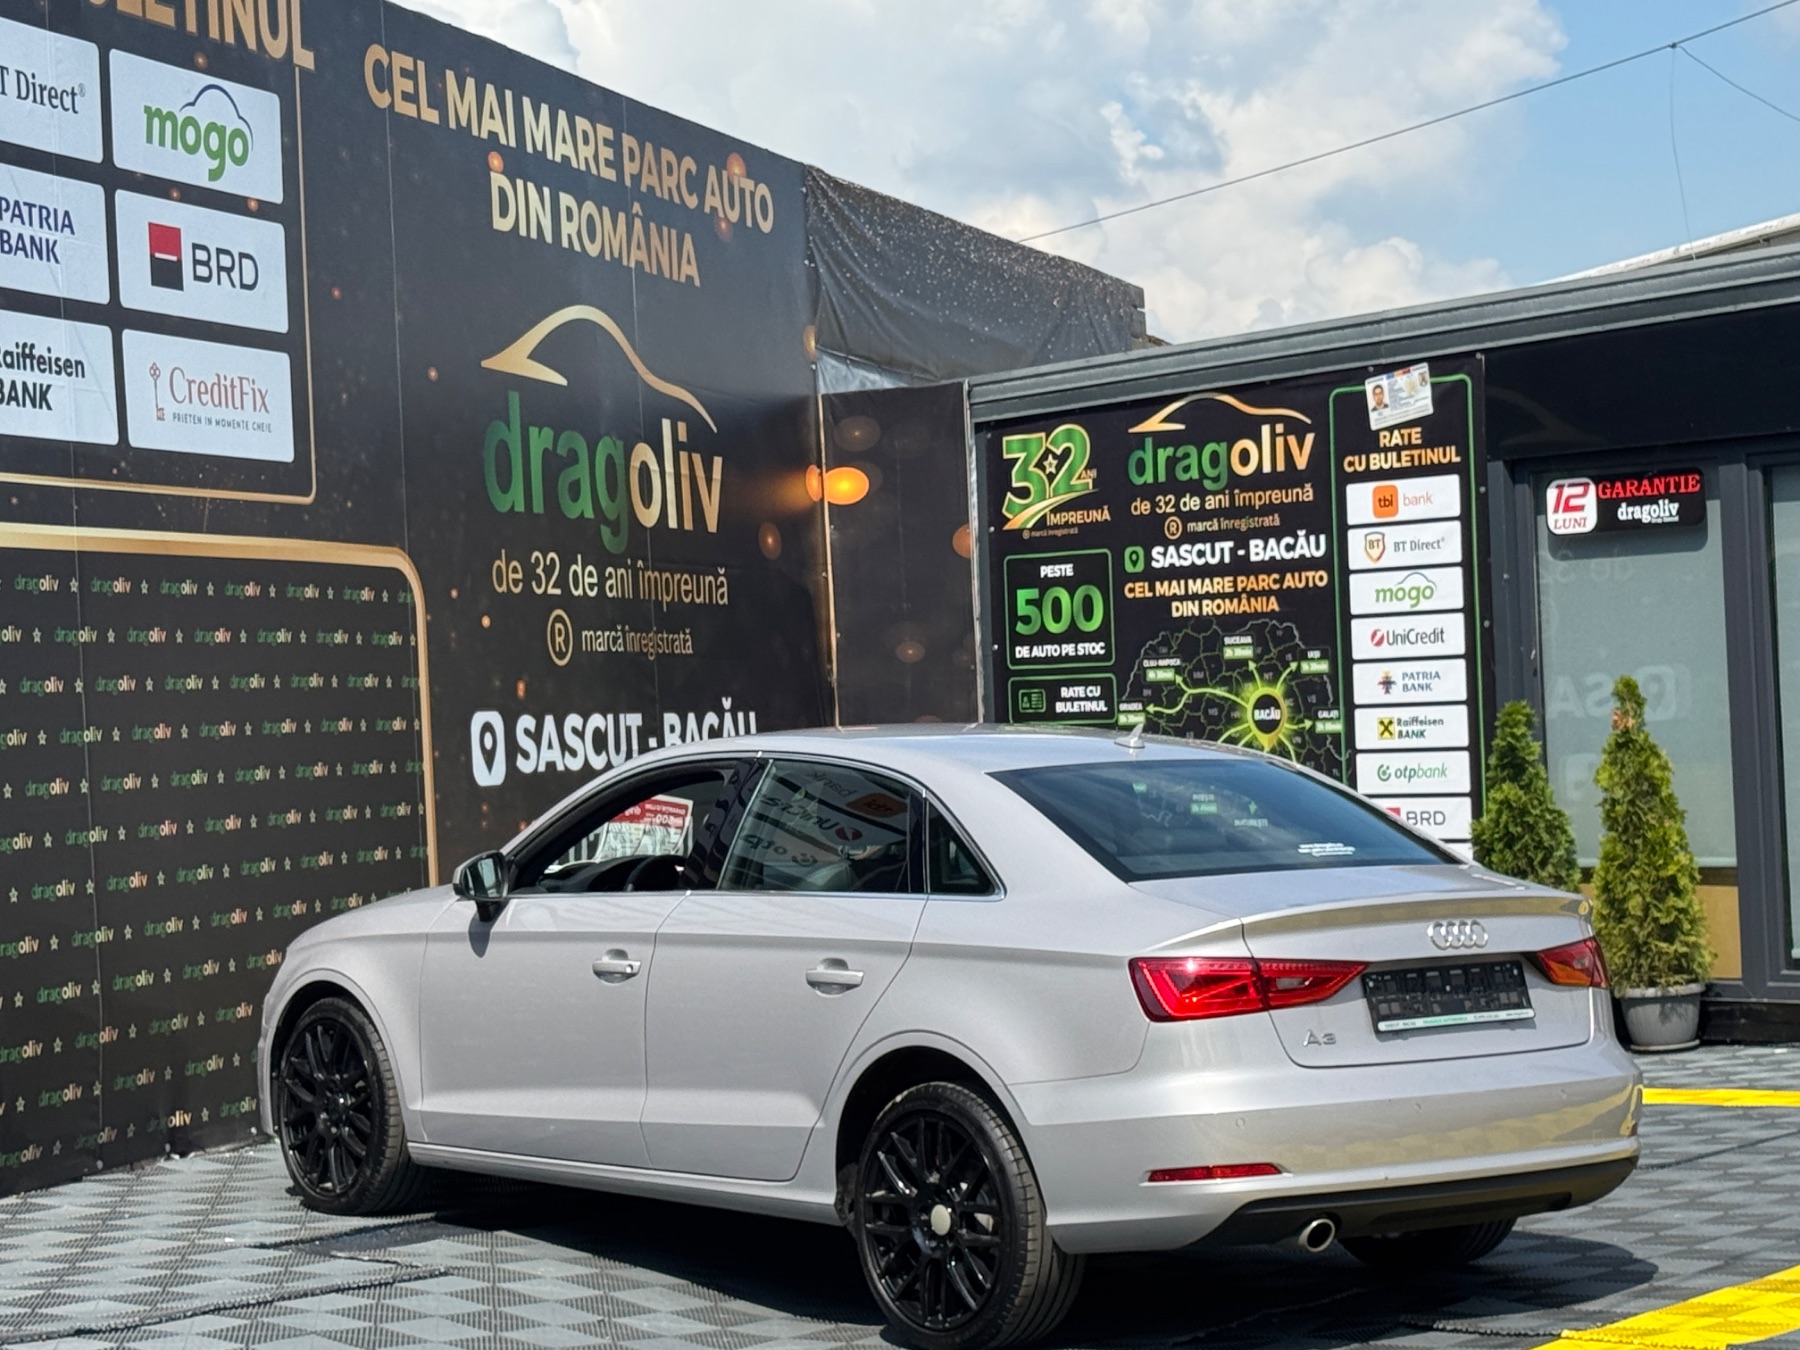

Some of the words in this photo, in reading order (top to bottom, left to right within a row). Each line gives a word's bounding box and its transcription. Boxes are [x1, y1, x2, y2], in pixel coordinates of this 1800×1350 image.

[144, 104, 249, 182] mogo
[364, 44, 439, 125] CEL
[445, 69, 516, 148] MAI
[522, 96, 616, 183] MARE
[622, 133, 698, 209] PARC
[704, 164, 774, 234] AUTO
[0, 196, 76, 236] PATRIA
[490, 170, 552, 245] DIN
[559, 191, 700, 287] ROMÂNIA
[0, 228, 61, 265] BANK
[191, 242, 259, 292] BRD
[0, 342, 86, 379] aiffeisen
[170, 366, 270, 414] CreditFix
[173, 412, 202, 425] PRIETEN
[205, 416, 212, 426] IN
[215, 418, 249, 431] MOMENTE
[252, 421, 272, 433] CHEIE
[1379, 427, 1422, 448] RATE
[1127, 423, 1315, 490] dragoliv
[1343, 454, 1366, 473] CU
[1369, 445, 1461, 470] BULETINUL
[483, 391, 723, 554] dragoliv
[1131, 498, 1150, 515] de
[1155, 494, 1176, 513] 32
[1180, 493, 1200, 511] de
[1205, 489, 1229, 510] ani
[1234, 483, 1313, 510] împreună
[1552, 482, 1590, 514] 12
[1597, 473, 1700, 499] GARANTIE
[1378, 495, 1393, 508] tbi
[1403, 491, 1433, 506] bank
[1617, 499, 1679, 523] dragoliv
[1046, 505, 1111, 526] ÎMPREUNĂ
[1187, 518, 1219, 532] marcă
[1220, 514, 1280, 531] înregistrată
[1553, 517, 1587, 530] LUNI
[1151, 541, 1234, 569] SASCUT
[1249, 530, 1326, 562] BACĂU
[1368, 538, 1381, 550] BT
[1394, 541, 1408, 552] BT
[492, 550, 523, 594] de
[530, 551, 562, 595] 32
[568, 554, 598, 597] de
[605, 559, 633, 599] ani
[637, 560, 728, 612] împreună
[1040, 564, 1074, 578] PESTE
[1124, 582, 1152, 598] CEL
[1155, 580, 1185, 596] MAI
[1188, 577, 1234, 595] MARE
[1237, 574, 1280, 592] PARC
[1283, 570, 1328, 589] AUTO
[14, 574, 59, 595] dragoliv
[91, 576, 132, 596] dragoliv
[160, 579, 198, 596] dragoliv
[225, 581, 261, 599] dragoliv
[286, 583, 319, 600] dragoliv
[343, 586, 375, 602] dragoliv
[1375, 584, 1435, 608] mogo
[1016, 584, 1104, 635] 500
[1171, 600, 1199, 618] DIN
[1202, 594, 1279, 616] ROMÂNIA
[54, 625, 97, 645] dragoliv
[127, 626, 166, 645] dragoliv
[194, 627, 231, 645] dragoliv
[257, 628, 292, 644] dragoliv
[316, 629, 349, 645] dragoliv
[372, 631, 403, 648] dragoliv
[582, 625, 624, 652] marcă
[626, 625, 693, 661] înregistrată
[1386, 627, 1445, 646] UniCredit
[1015, 646, 1030, 658] DE
[1031, 644, 1060, 658] AUTO
[1062, 644, 1076, 656] PE
[1077, 642, 1105, 655] STOC
[19, 676, 64, 696] dragoliv
[96, 675, 136, 694] dragoliv
[165, 674, 203, 693] dragoliv
[230, 673, 265, 691] dragoliv
[291, 673, 323, 690] dragoliv
[347, 673, 379, 689] dragoliv
[1402, 671, 1441, 681] PATRIA
[1402, 682, 1433, 692] BANK
[1061, 686, 1085, 698] RATE
[1087, 686, 1101, 697] CU
[1056, 700, 1108, 713] BULETINUL
[1254, 706, 1281, 721] BACĂU
[59, 726, 102, 746] dragoliv
[132, 723, 172, 742] dragoliv
[200, 720, 236, 739] dragoliv
[262, 719, 297, 736] dragoliv
[321, 717, 353, 734] dragoliv
[376, 716, 407, 733] dragoliv
[1397, 716, 1444, 727] Raiffeisen
[1398, 730, 1427, 739] BANK
[515, 712, 643, 774] SASCUT
[25, 778, 69, 799] dragoliv
[101, 773, 141, 794] dragoliv
[171, 770, 208, 789] dragoliv
[235, 765, 270, 783] dragoliv
[295, 761, 328, 779] dragoliv
[352, 759, 383, 778] dragoliv
[1395, 763, 1447, 783] otpbank
[65, 826, 108, 847] dragoliv
[137, 820, 177, 840] dragoliv
[205, 814, 242, 833] dragoliv
[268, 809, 301, 828] dragoliv
[325, 805, 358, 822] dragoliv
[380, 802, 411, 819] dragoliv
[1406, 811, 1445, 826] BRD
[31, 879, 75, 900] dragoliv
[106, 871, 147, 892] dragoliv
[176, 864, 213, 883] dragoliv
[240, 857, 276, 877] dragoliv
[300, 851, 334, 870] dragoliv
[357, 846, 388, 865] dragoliv
[72, 926, 114, 948] dragoliv
[144, 916, 183, 938] dragoliv
[211, 908, 247, 928] dragoliv
[273, 900, 307, 920] dragoliv
[37, 981, 81, 1005] dragoliv
[112, 970, 154, 991] dragoliv
[182, 959, 219, 981] dragoliv
[246, 949, 282, 969] dragoliv
[1303, 1029, 1336, 1047] A3
